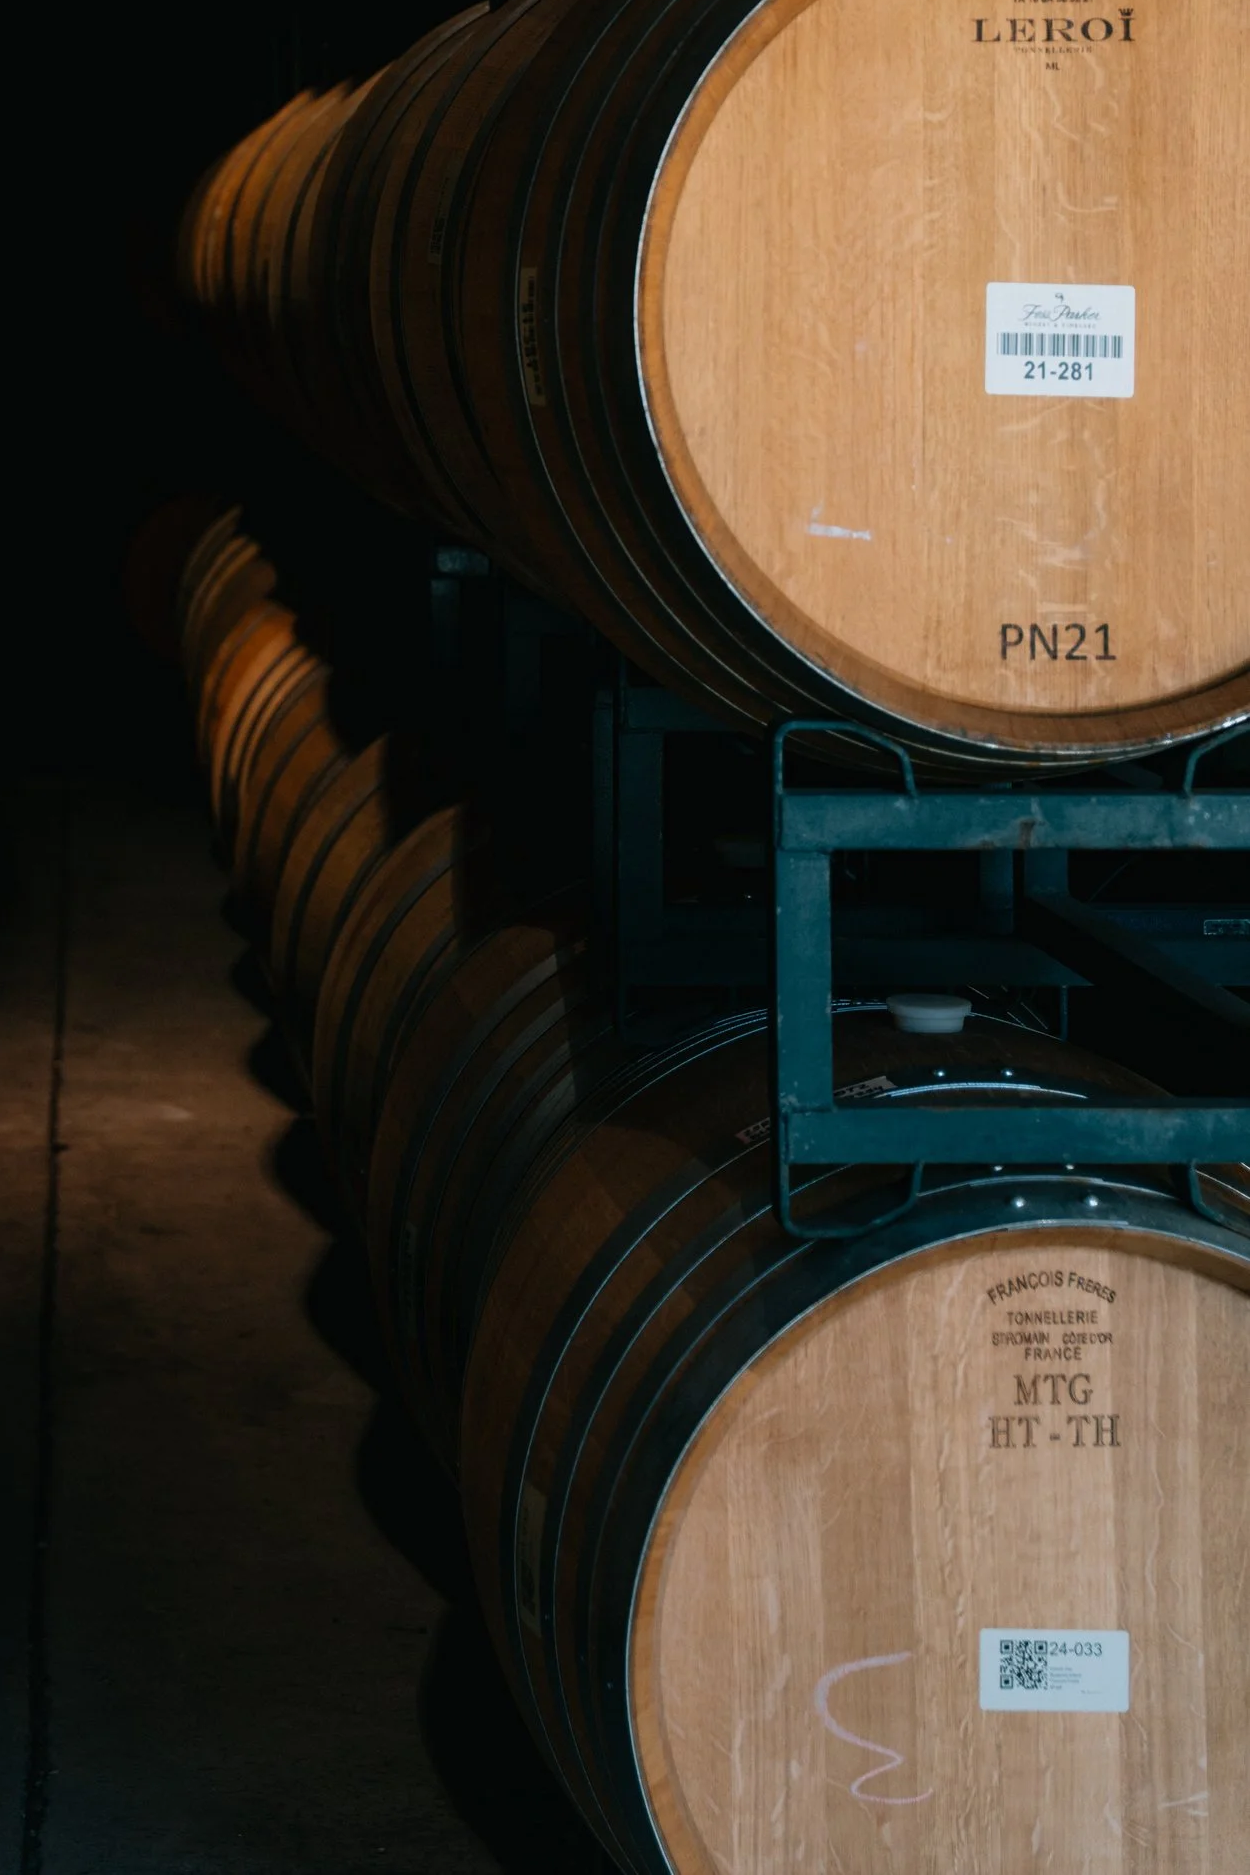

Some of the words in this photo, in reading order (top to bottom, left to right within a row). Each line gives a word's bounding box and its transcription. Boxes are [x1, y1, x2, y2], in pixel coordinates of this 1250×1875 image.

[1024, 360, 1093, 381] 21-281
[1000, 623, 1117, 660] PN21
[986, 1270, 1064, 1306] FRANÇOIS
[1007, 1309, 1099, 1326] TONNELLERIE
[1024, 1346, 1082, 1362] FRANCE
[1013, 1372, 1094, 1406] MTG
[1049, 1641, 1103, 1657] 24-033
